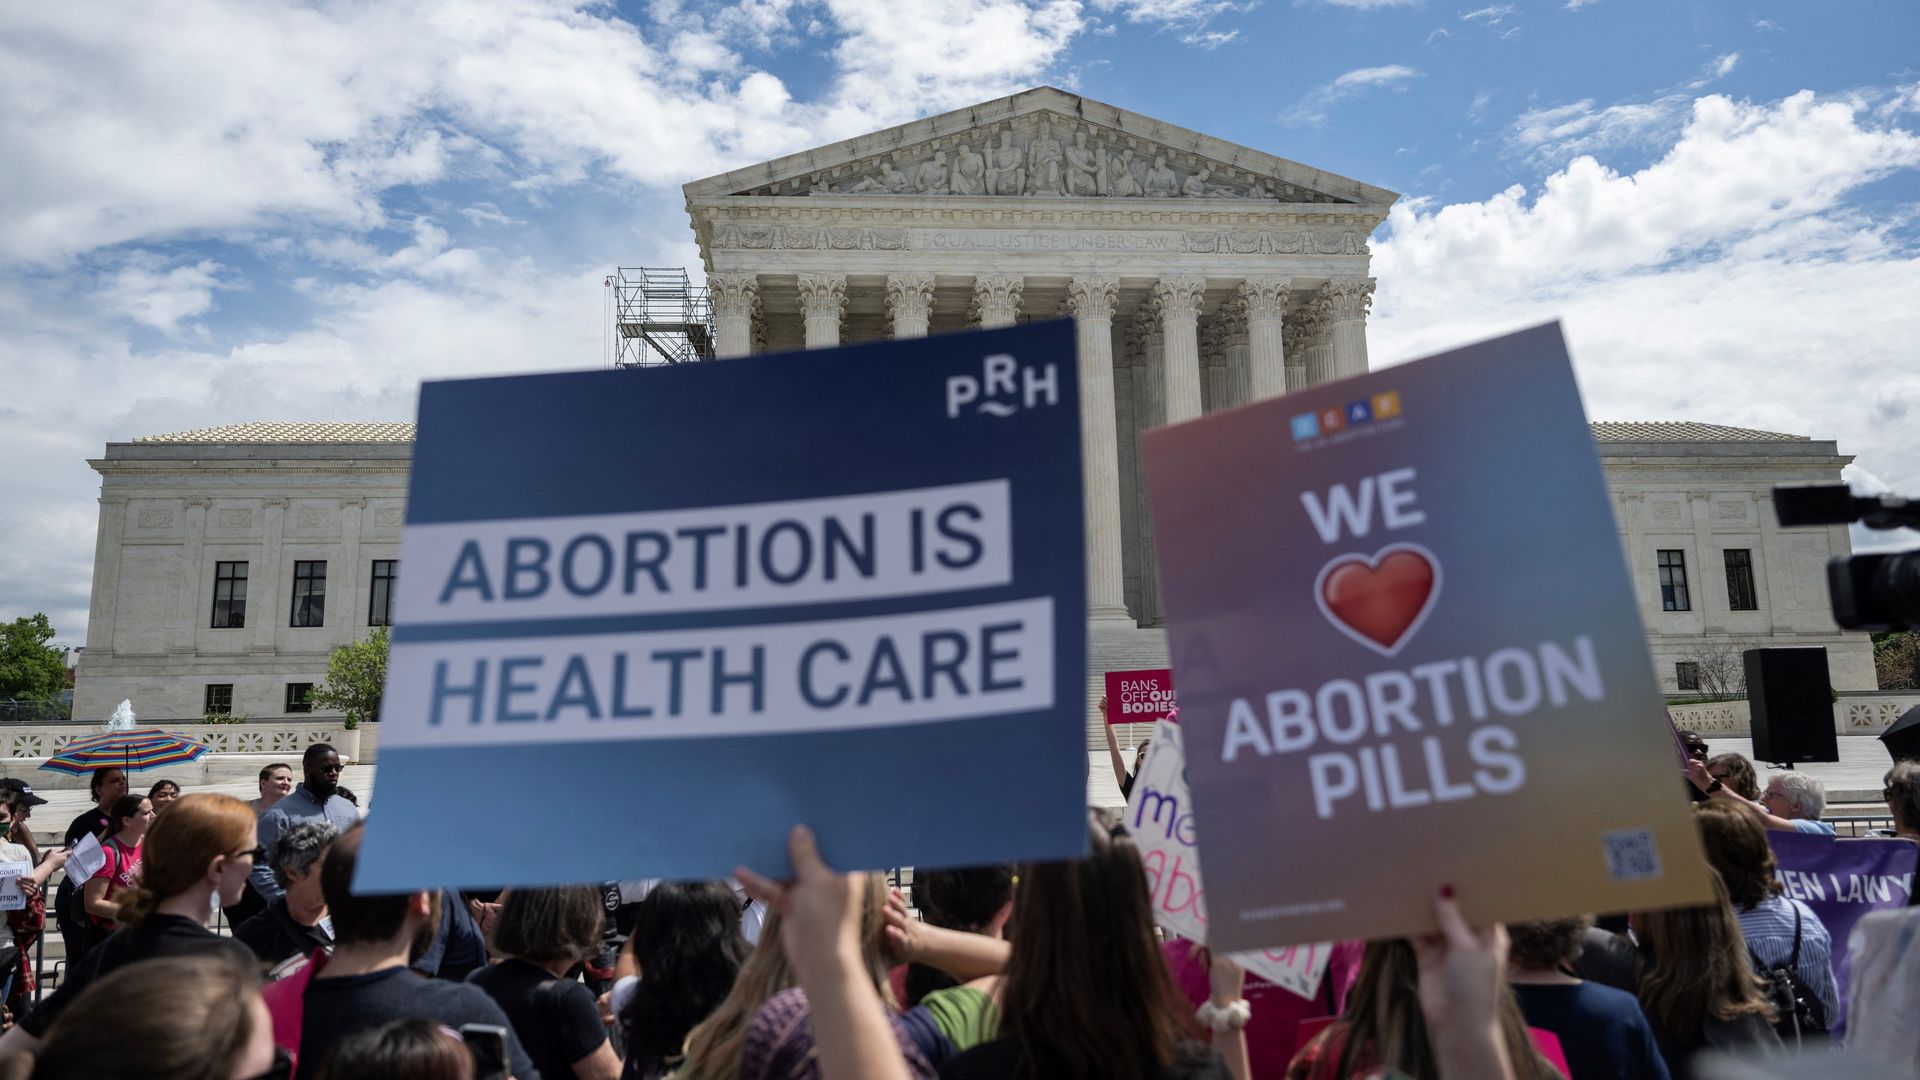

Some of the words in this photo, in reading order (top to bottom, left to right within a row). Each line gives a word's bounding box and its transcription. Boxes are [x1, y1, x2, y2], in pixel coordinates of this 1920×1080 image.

[922, 233, 984, 248] EQUAL
[991, 233, 1059, 250] JUSTICE
[1068, 234, 1126, 249] UNDER
[1135, 235, 1169, 248] LAW
[946, 353, 1058, 419] PRH
[1300, 467, 1427, 544] WE
[438, 511, 877, 605] ABORTION
[909, 502, 986, 576] IS
[426, 645, 767, 727] HEALTH
[799, 620, 1025, 710] CARE
[1120, 690, 1148, 703] OFF
[1121, 679, 1158, 692] BANS
[1122, 701, 1176, 714] BODIES
[1221, 635, 1605, 762] ABORTION
[1308, 725, 1526, 819] PILLS
